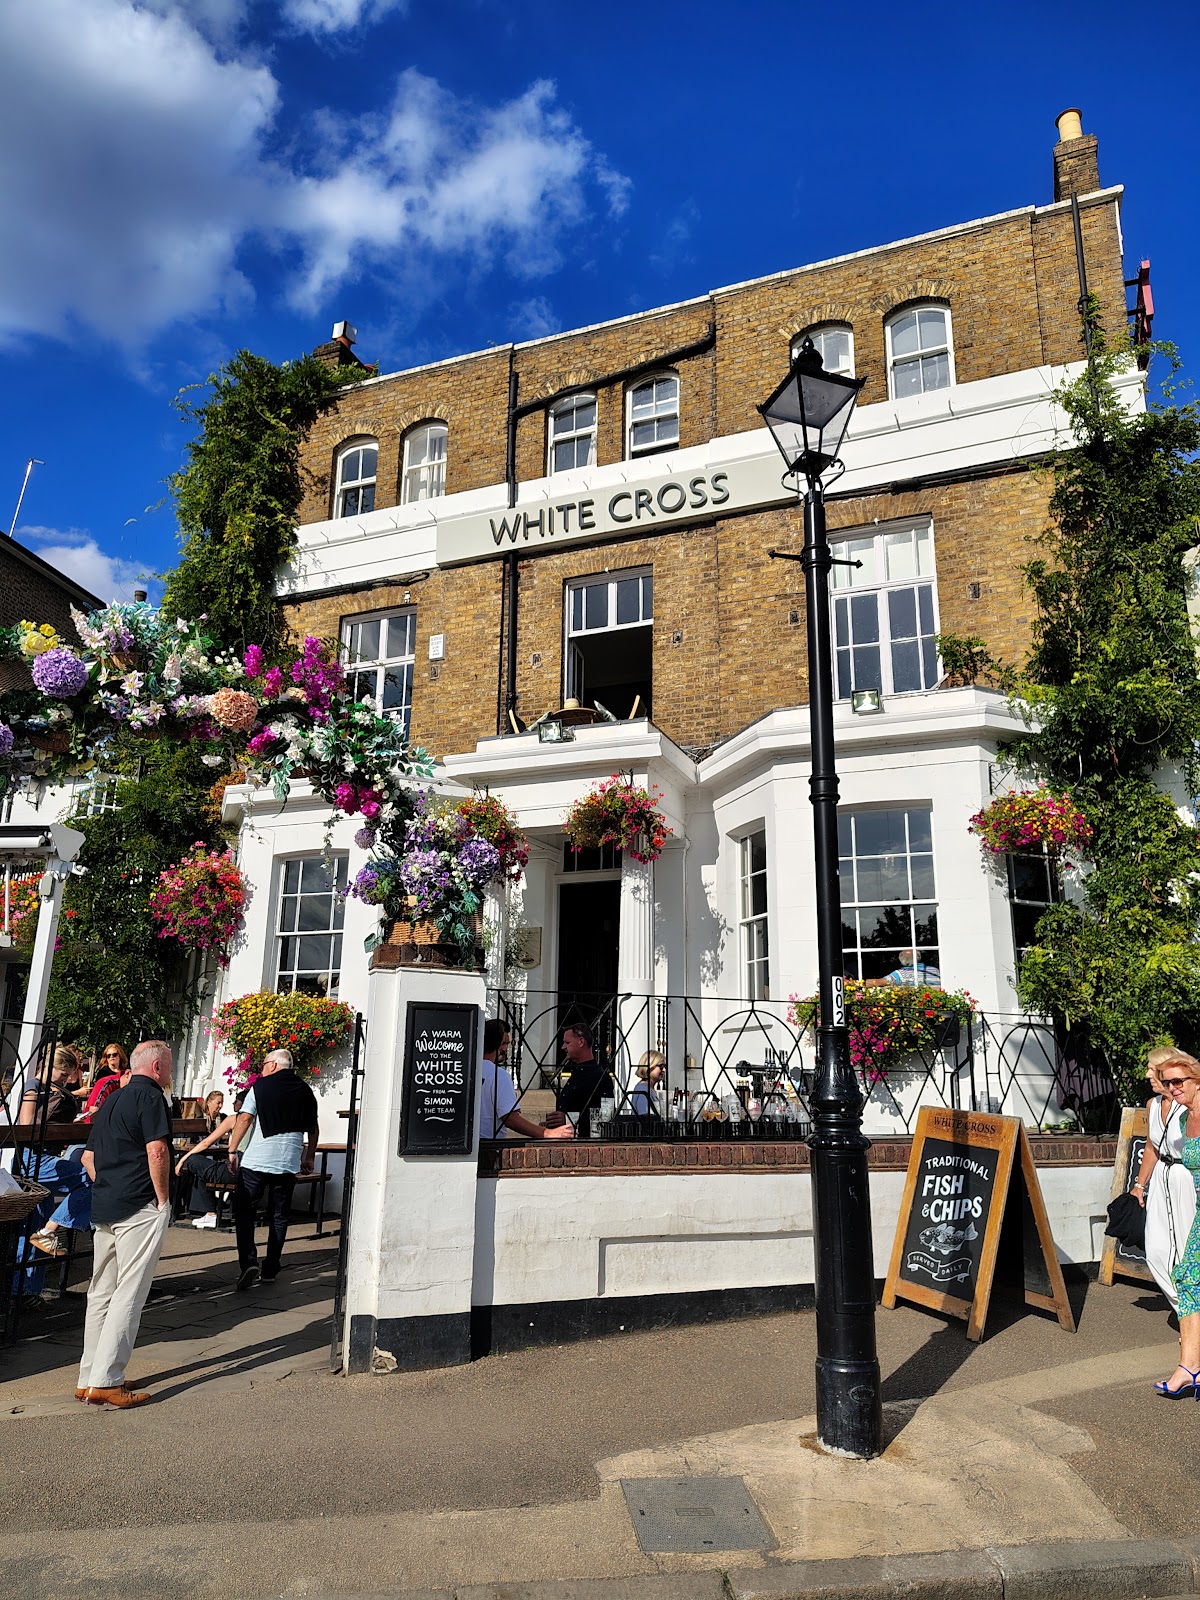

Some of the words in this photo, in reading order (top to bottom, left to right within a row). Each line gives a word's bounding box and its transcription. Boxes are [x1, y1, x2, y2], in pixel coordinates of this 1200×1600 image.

[489, 499, 596, 546] WHITE
[608, 472, 730, 522] CROSS
[835, 978, 844, 1025] 002
[431, 1030, 461, 1038] WARM
[415, 1038, 464, 1052] Welcome
[415, 1061, 462, 1071] WHITE
[414, 1073, 463, 1085] CROSS
[424, 1097, 453, 1105] SIMON
[933, 1116, 964, 1129] WHITE
[965, 1120, 997, 1135] CROSS
[925, 1155, 990, 1181] TRADITIONAL
[921, 1174, 965, 1197] FISH
[912, 1255, 935, 1268] SERVED
[941, 1264, 963, 1275] DAILY
